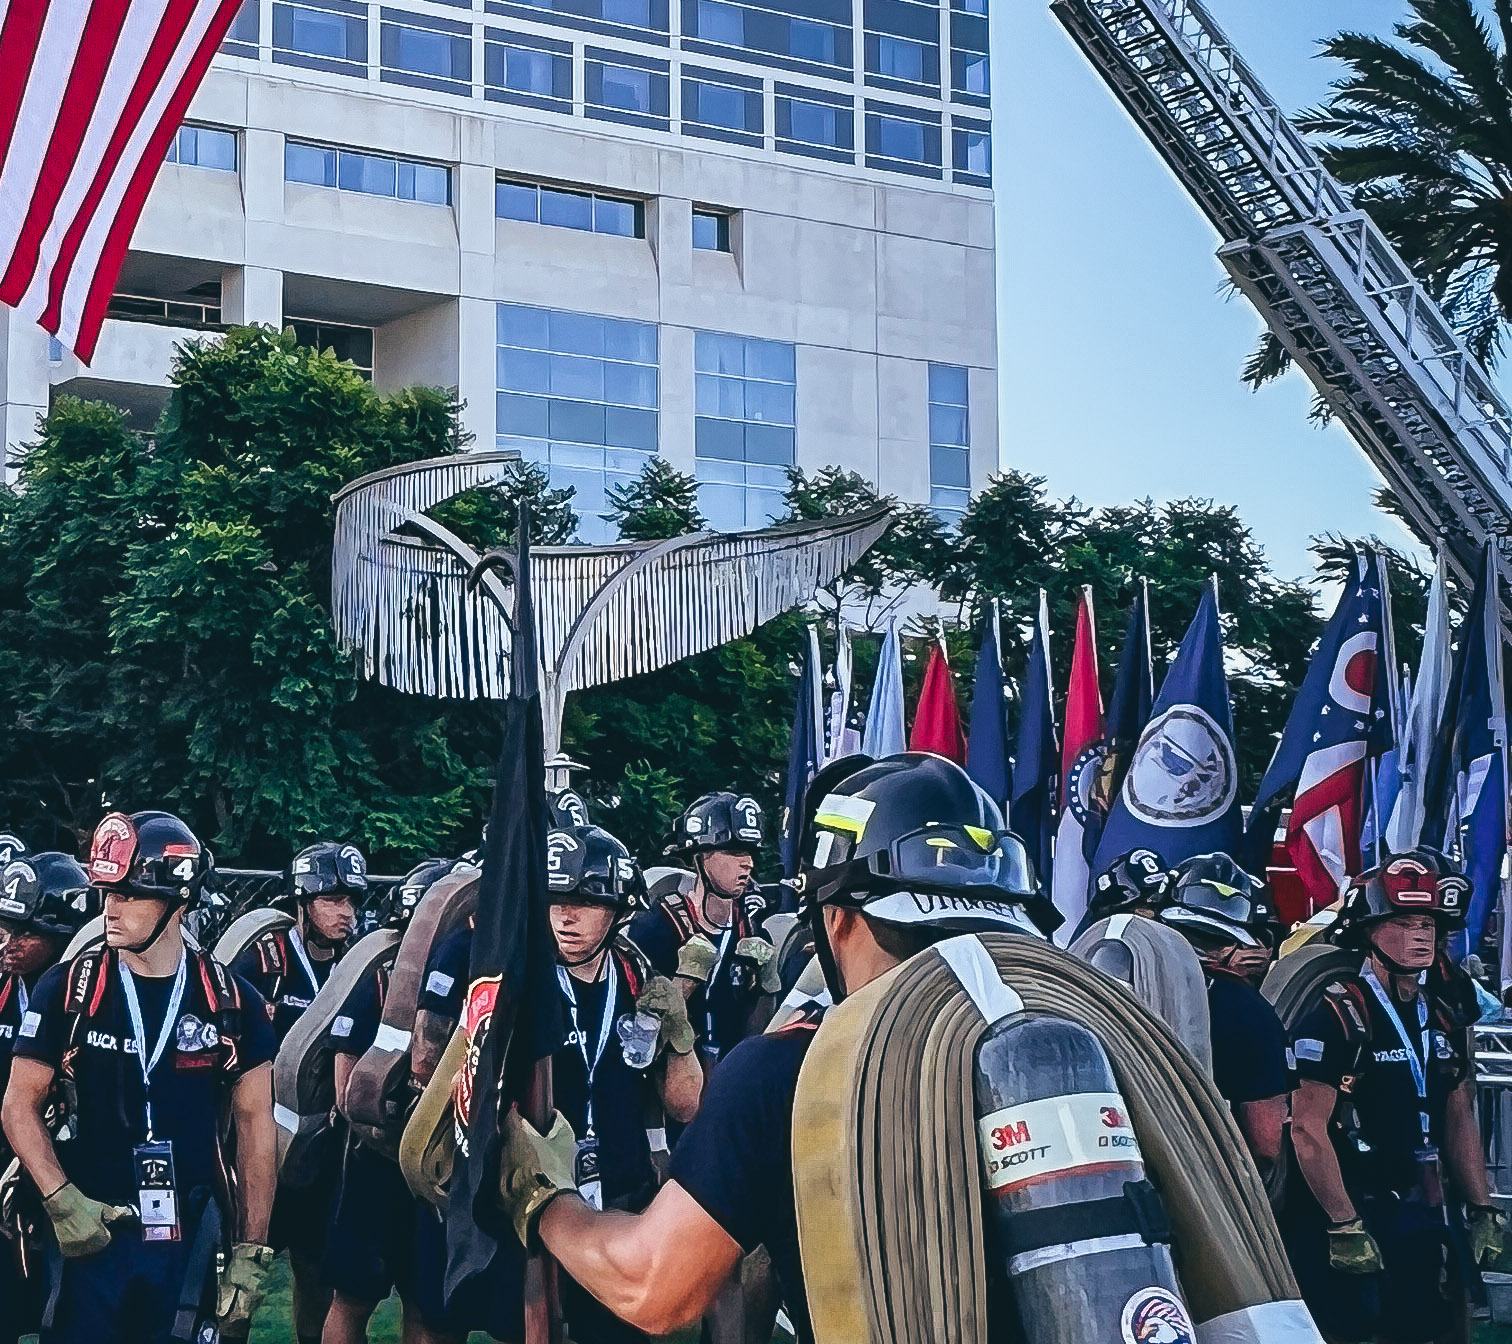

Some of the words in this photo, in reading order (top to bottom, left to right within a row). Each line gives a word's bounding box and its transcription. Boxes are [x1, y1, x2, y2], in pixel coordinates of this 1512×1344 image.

[745, 807, 757, 827] 6
[811, 830, 834, 869] 1
[172, 859, 194, 881] 4
[296, 858, 311, 873] 5
[617, 858, 634, 880] 5
[4, 878, 19, 900] 4
[402, 889, 416, 905] 5
[990, 1120, 1031, 1150] 3M
[1001, 1145, 1051, 1169] SCOTT
